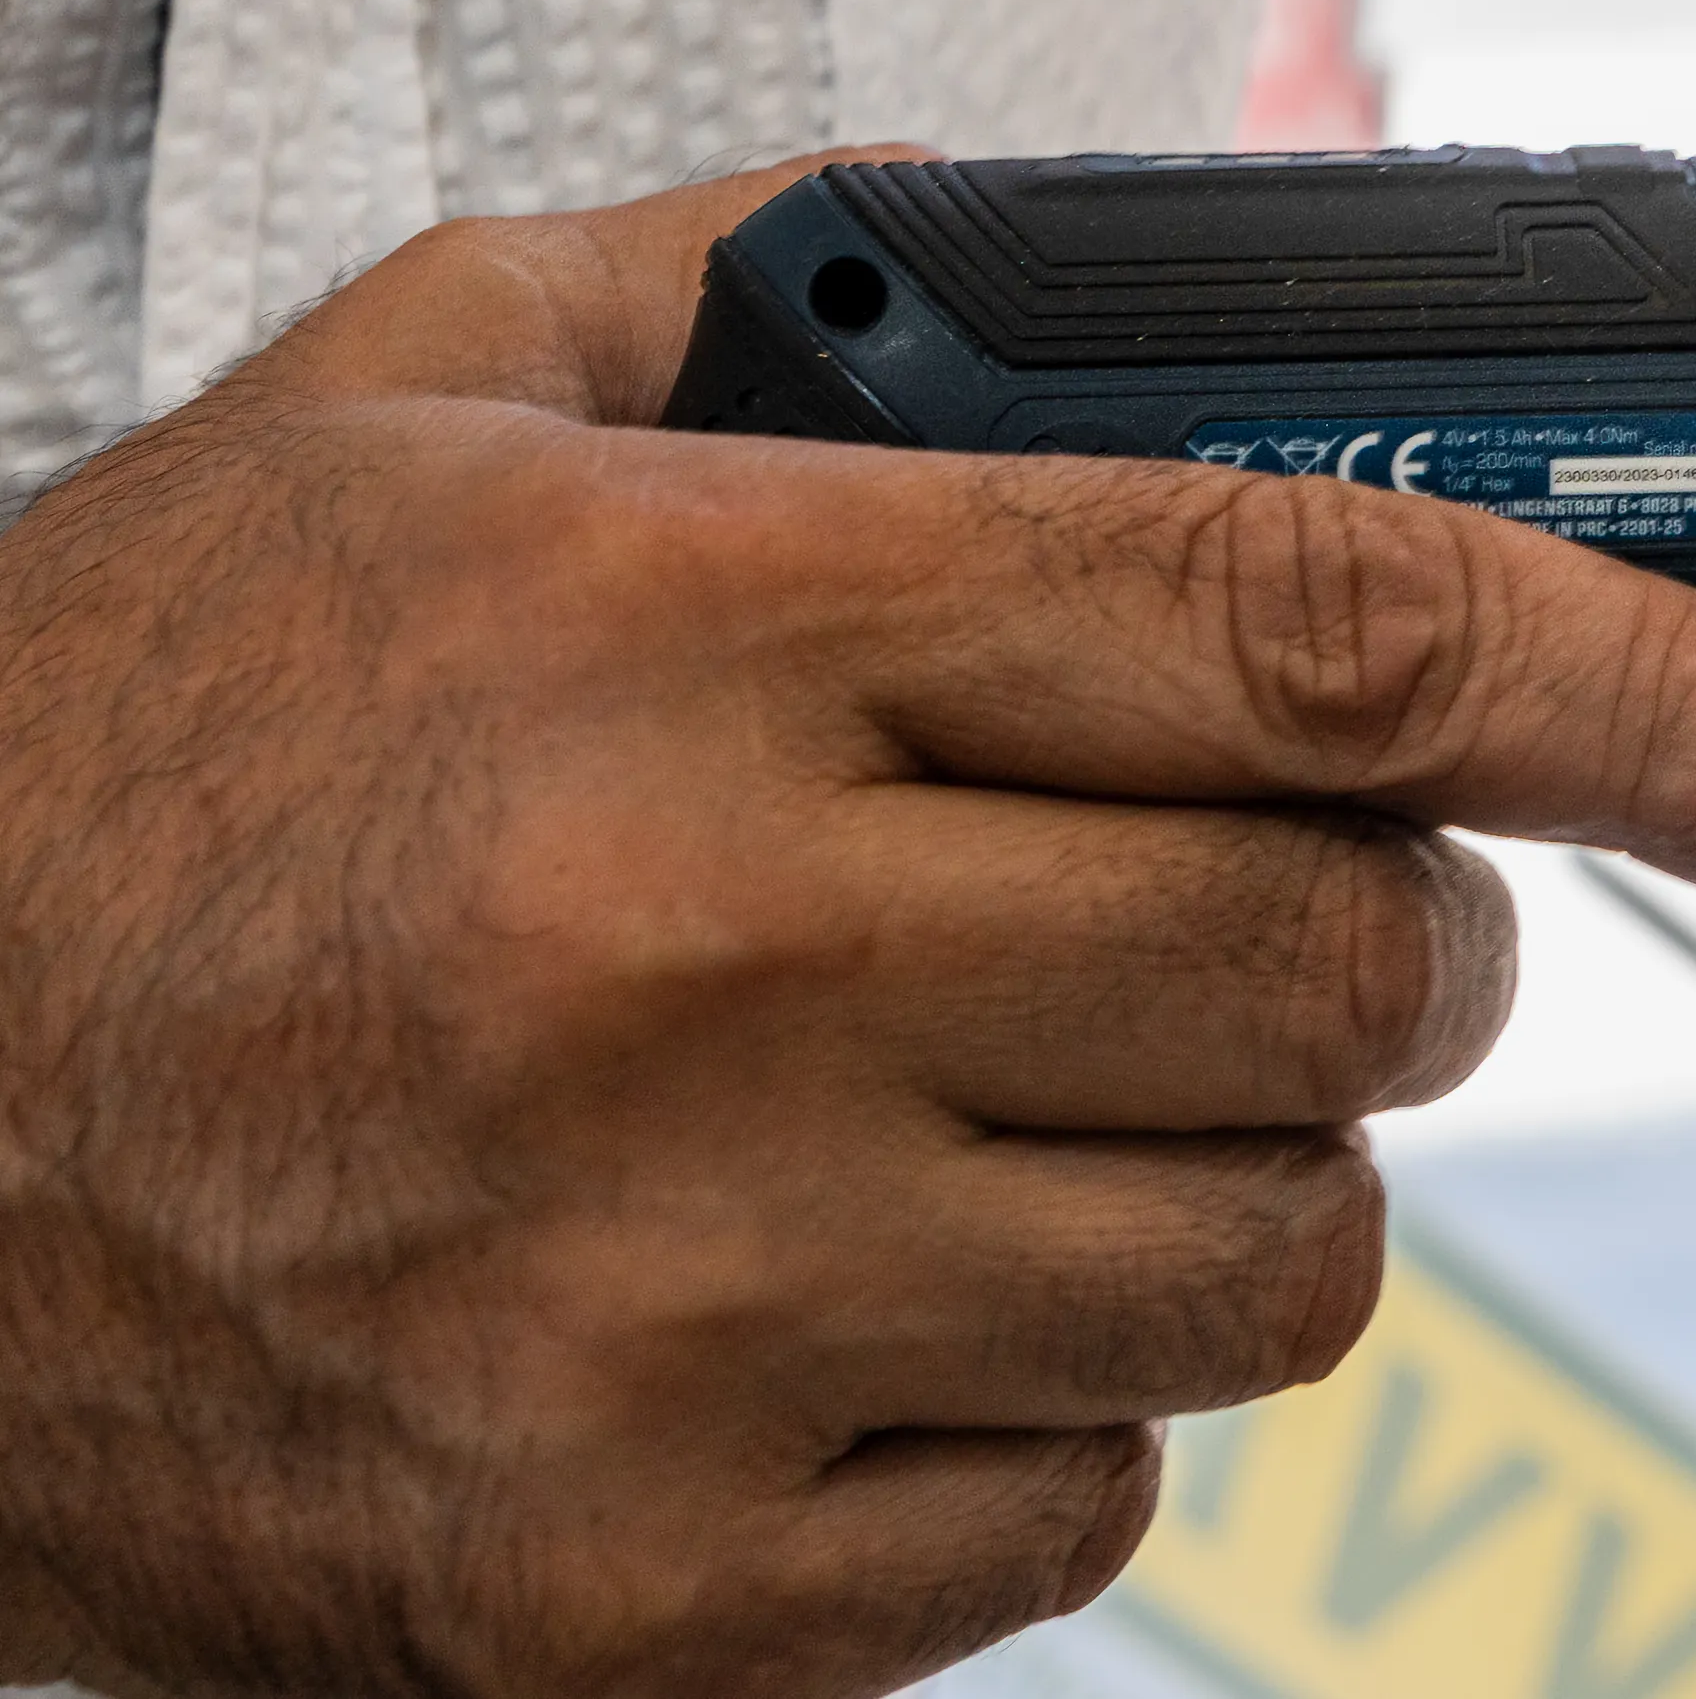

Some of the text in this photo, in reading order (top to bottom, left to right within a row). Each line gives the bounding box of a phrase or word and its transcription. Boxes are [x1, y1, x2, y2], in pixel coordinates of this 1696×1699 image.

[1644, 440, 1686, 456] Serial
[1481, 475, 1512, 492] Hex
[1499, 497, 1613, 517] LINGENSTRAAT
[1576, 520, 1607, 537] PRC
[1619, 518, 1684, 537] 2201-25
